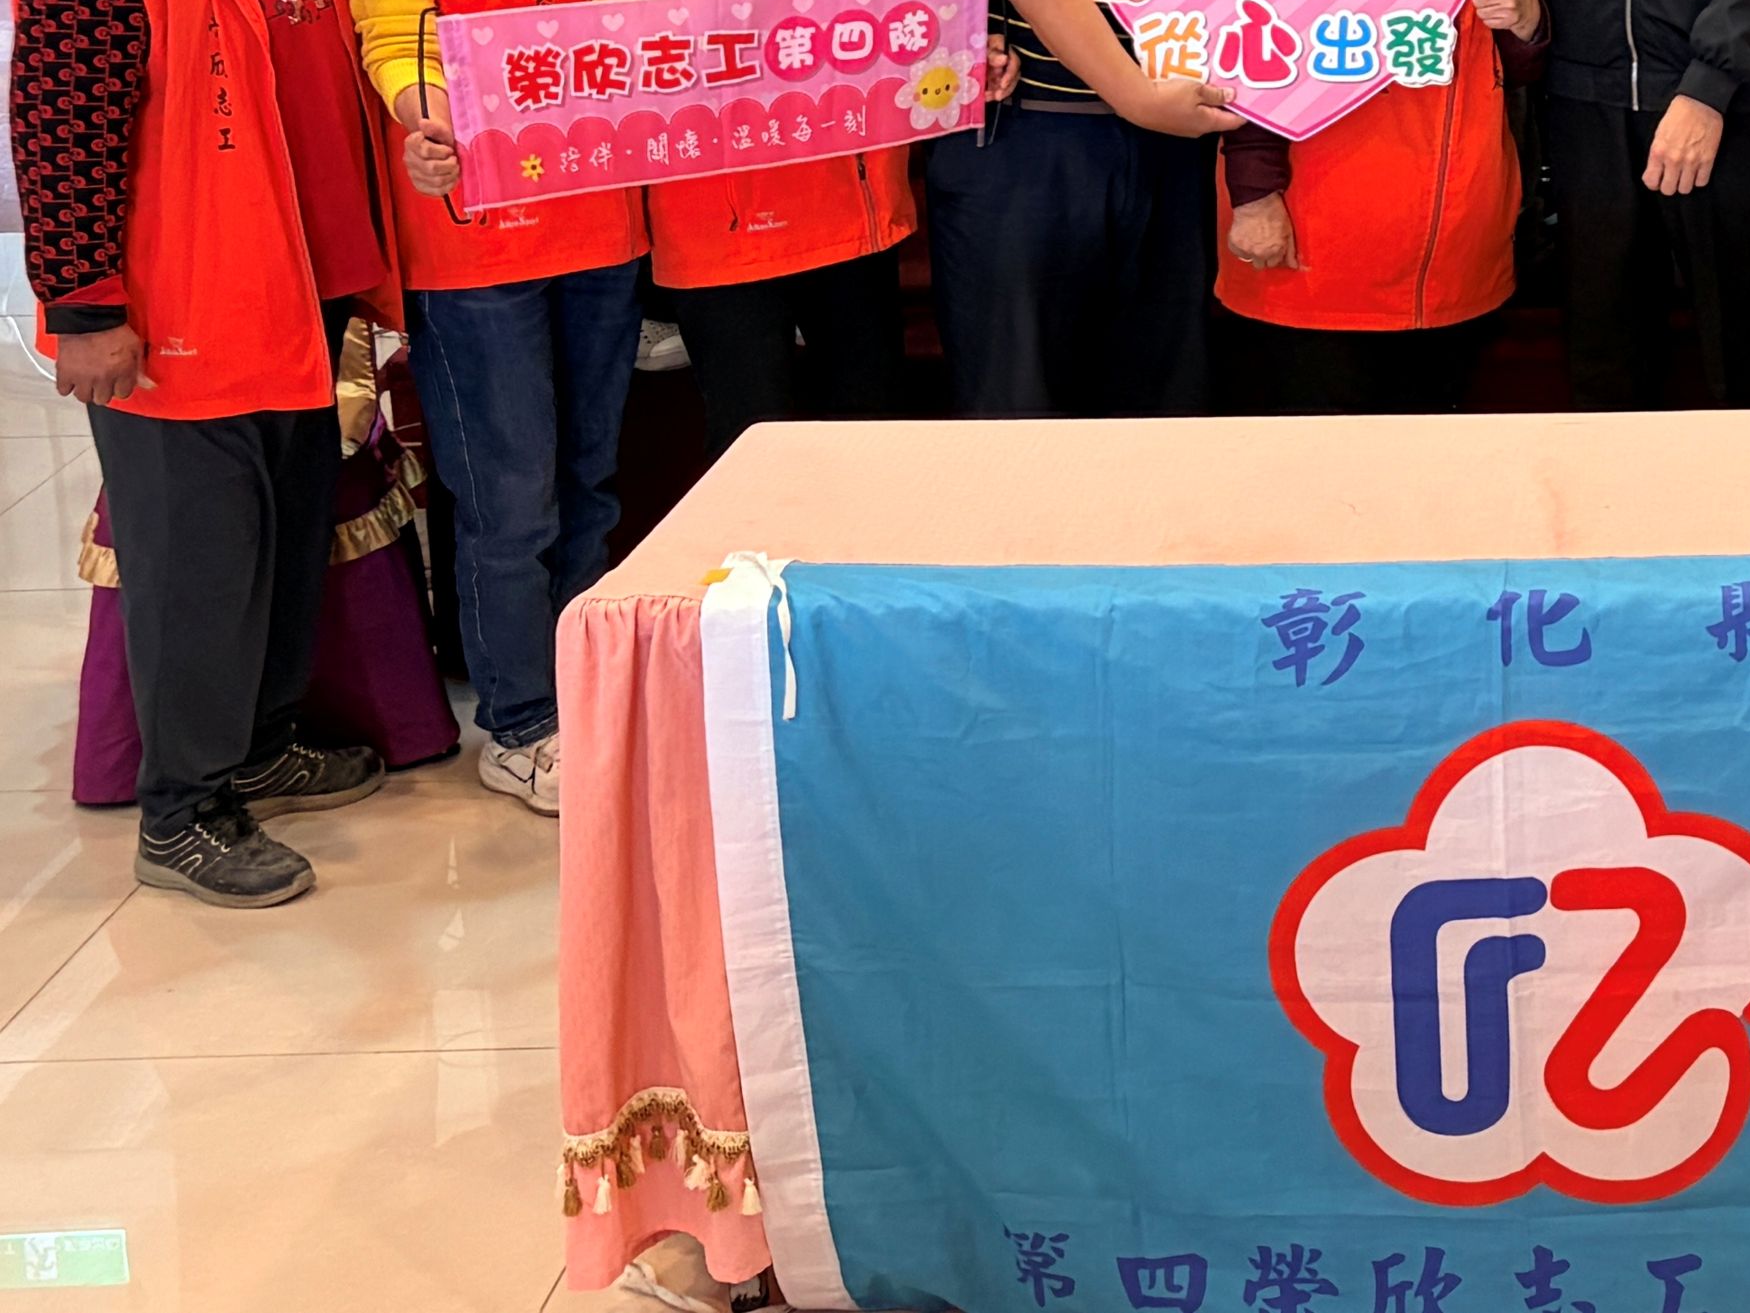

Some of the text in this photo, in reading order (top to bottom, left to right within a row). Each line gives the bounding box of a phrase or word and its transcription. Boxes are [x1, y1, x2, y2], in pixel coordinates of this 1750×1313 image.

[503, 8, 930, 110] 榮欣志工第四隊
